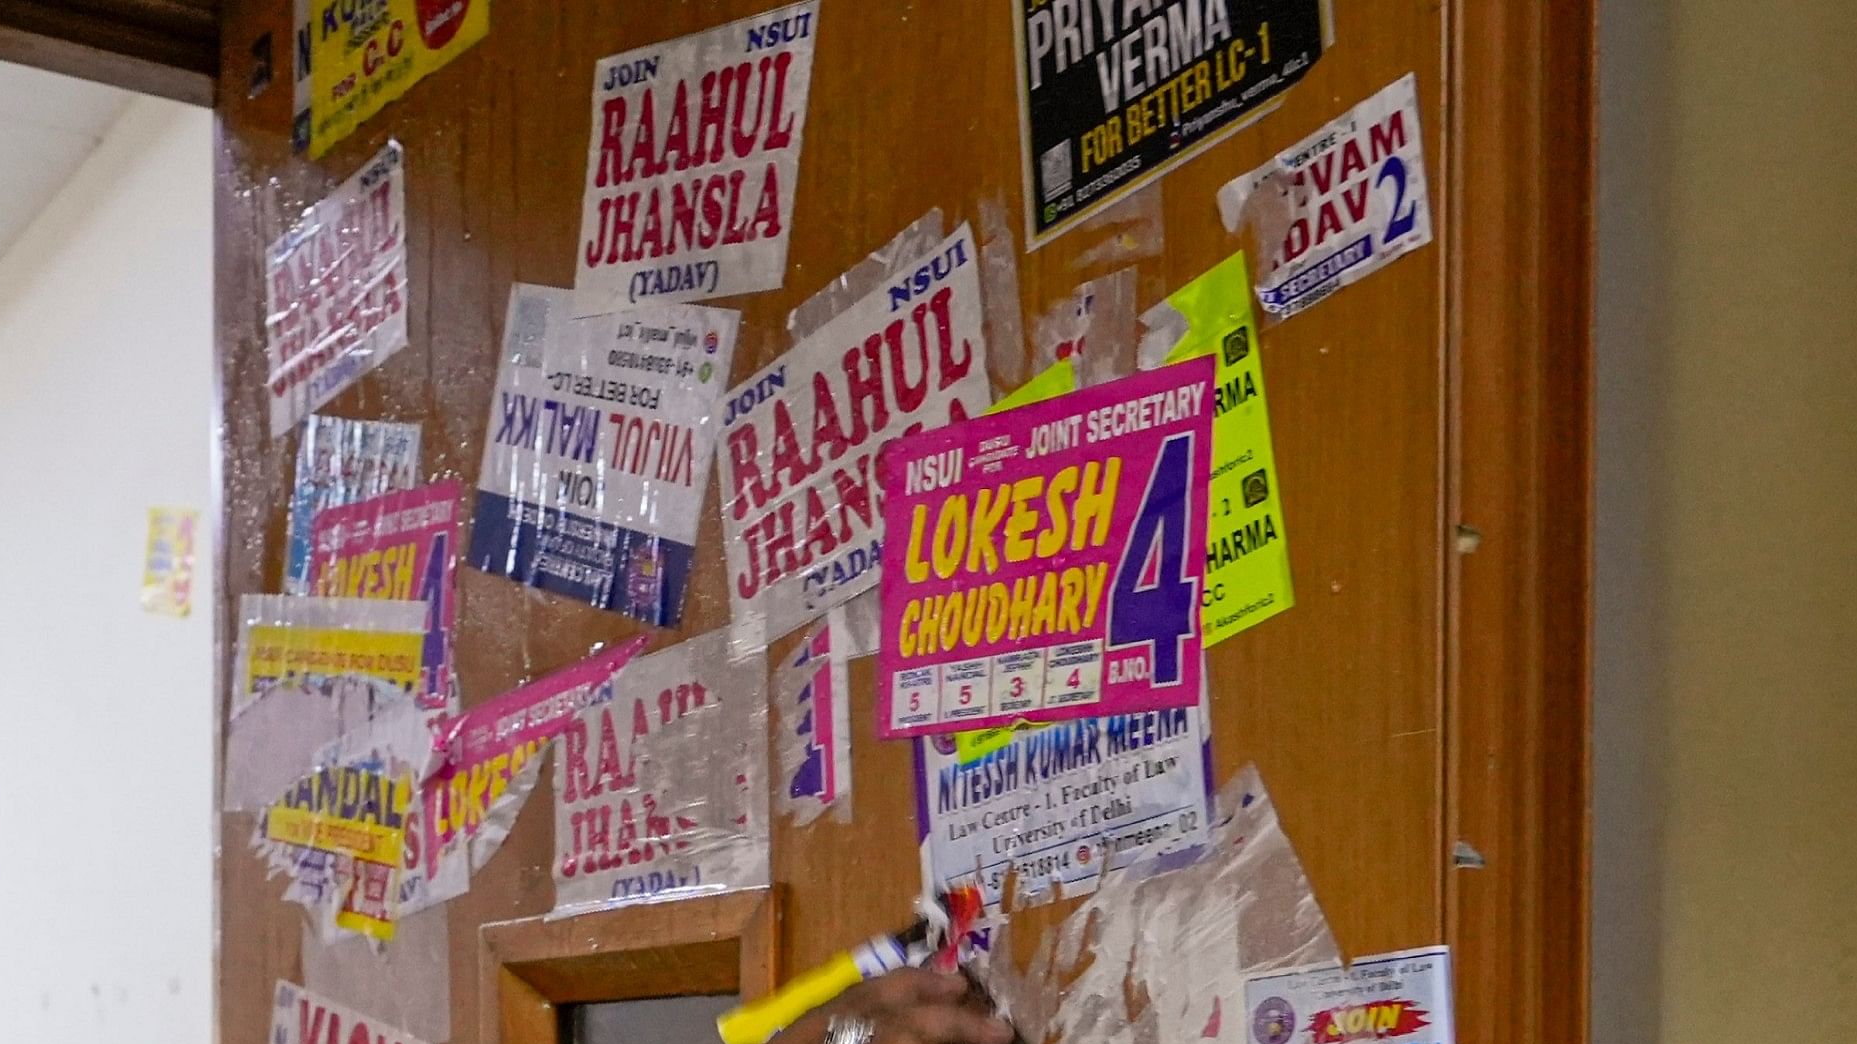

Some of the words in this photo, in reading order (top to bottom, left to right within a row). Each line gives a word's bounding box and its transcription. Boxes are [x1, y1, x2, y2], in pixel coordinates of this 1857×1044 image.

[603, 55, 661, 91] JOIN
[746, 12, 812, 52] NSUI
[1096, 0, 1232, 114] VERMA
[595, 51, 796, 188] RAAHUL
[1080, 115, 1123, 173] FOR
[1125, 60, 1212, 147] BETTER
[1291, 132, 1337, 168] ENTRE
[585, 162, 782, 268] JHANSLA
[1375, 156, 1417, 245] 2
[629, 260, 719, 303] (YADAV)
[724, 364, 787, 427] JOIN
[888, 238, 969, 313] NSUI
[629, 386, 661, 410] FOR
[727, 285, 973, 522] RAAHUL
[905, 447, 963, 496] NSUI
[1025, 419, 1081, 460] JOINT
[1086, 381, 1206, 444] SECRETARY
[905, 455, 1123, 584] LOKESH
[1105, 430, 1200, 690] 4
[899, 561, 1108, 658] CHOUDHARY
[959, 685, 972, 705] 5
[1010, 676, 1025, 698] 3
[1066, 668, 1081, 689] 4
[1025, 716, 1102, 785] KUMAR
[1106, 706, 1190, 758] MEENA
[948, 819, 979, 843] Law
[981, 802, 1031, 830] Centre
[1061, 772, 1120, 806] Faculty
[1122, 763, 1140, 784] of
[1144, 753, 1181, 778] Law
[1327, 1004, 1403, 1036] JOIN
